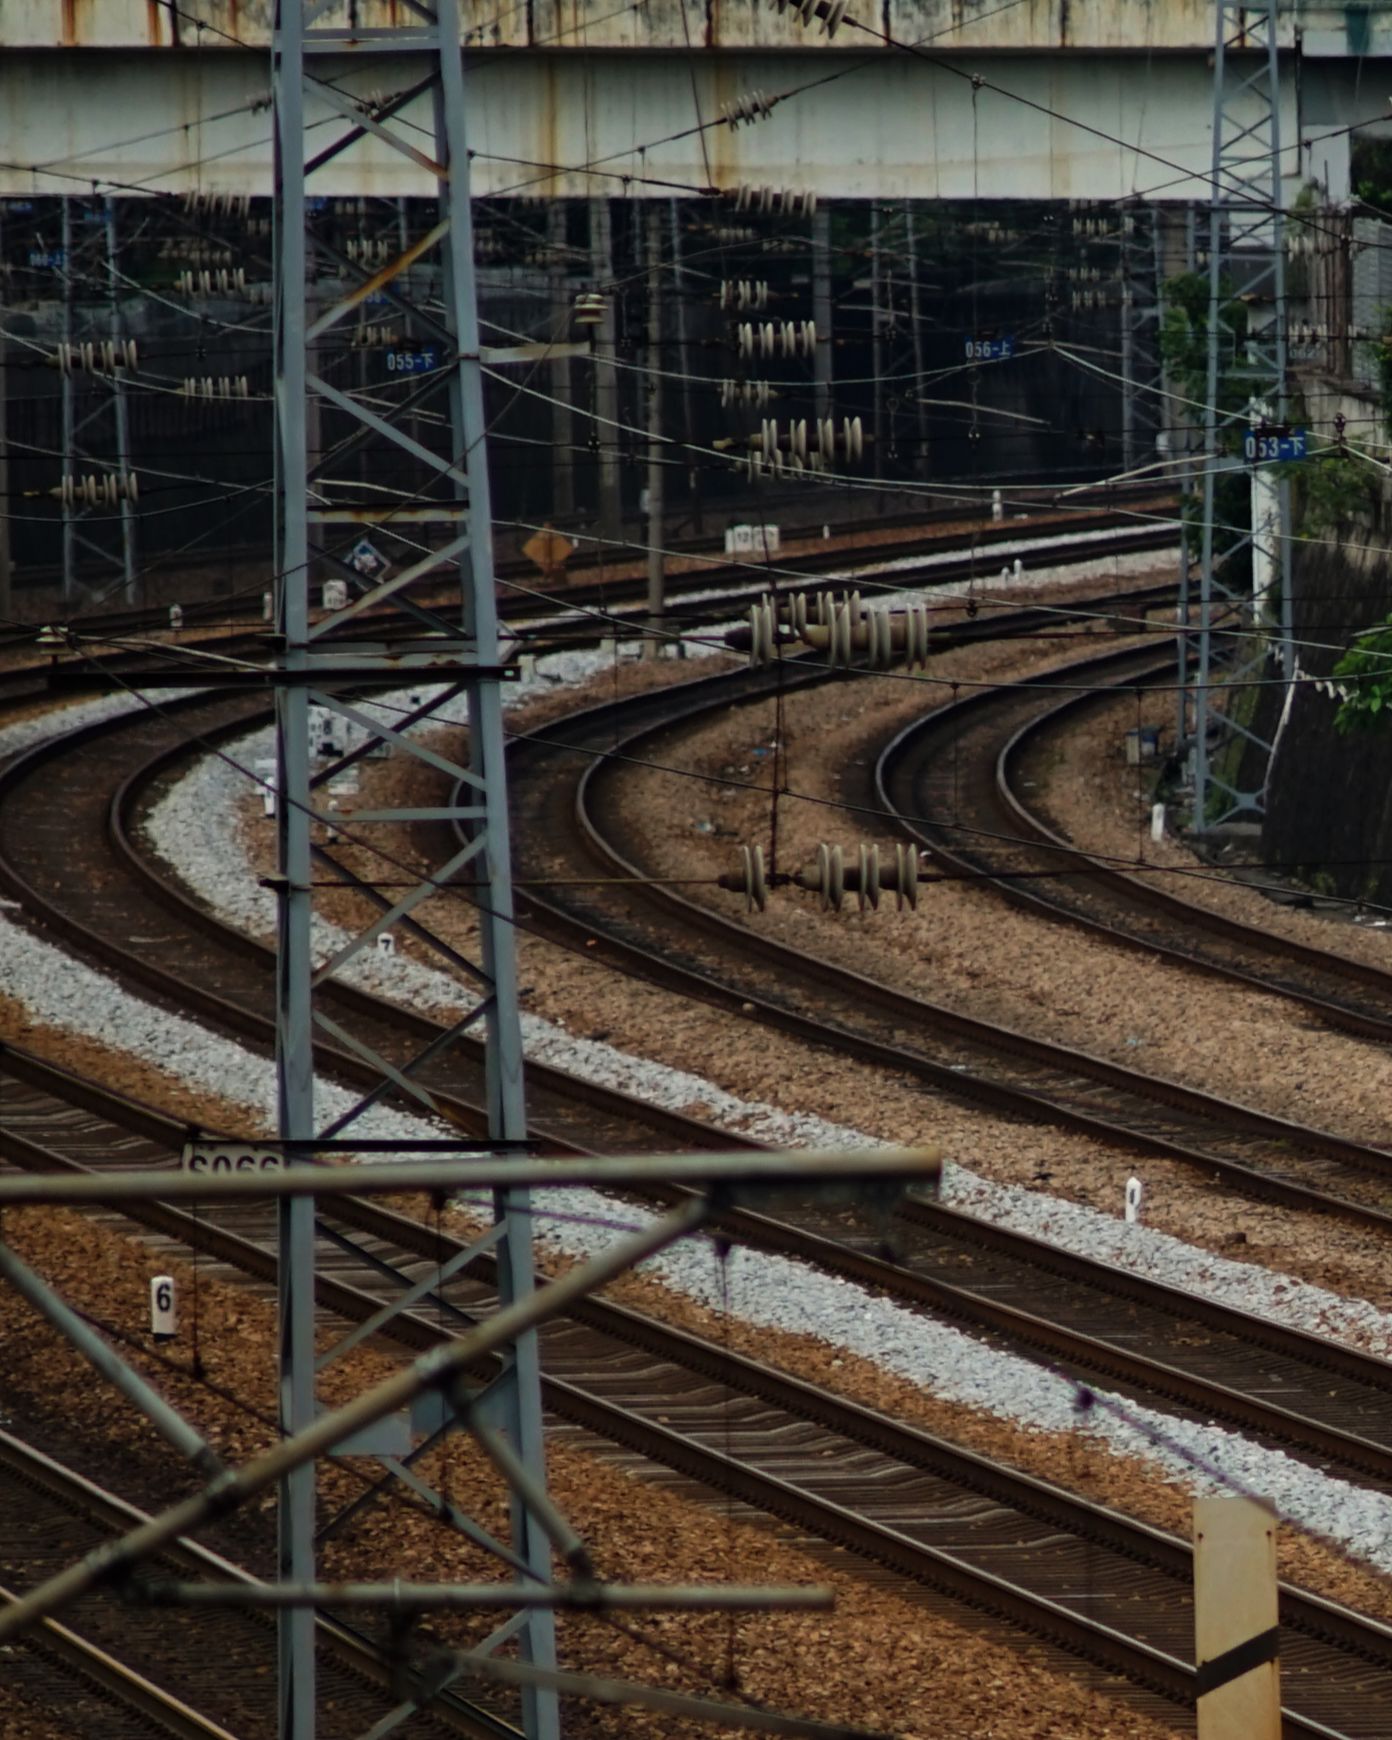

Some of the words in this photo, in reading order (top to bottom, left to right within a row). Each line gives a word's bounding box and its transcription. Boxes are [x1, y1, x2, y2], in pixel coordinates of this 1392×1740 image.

[965, 340, 1011, 358] 056-上
[387, 353, 434, 370] 055-下
[1245, 436, 1304, 458] 053-下
[381, 939, 391, 951] 7
[156, 1284, 170, 1312] 6
